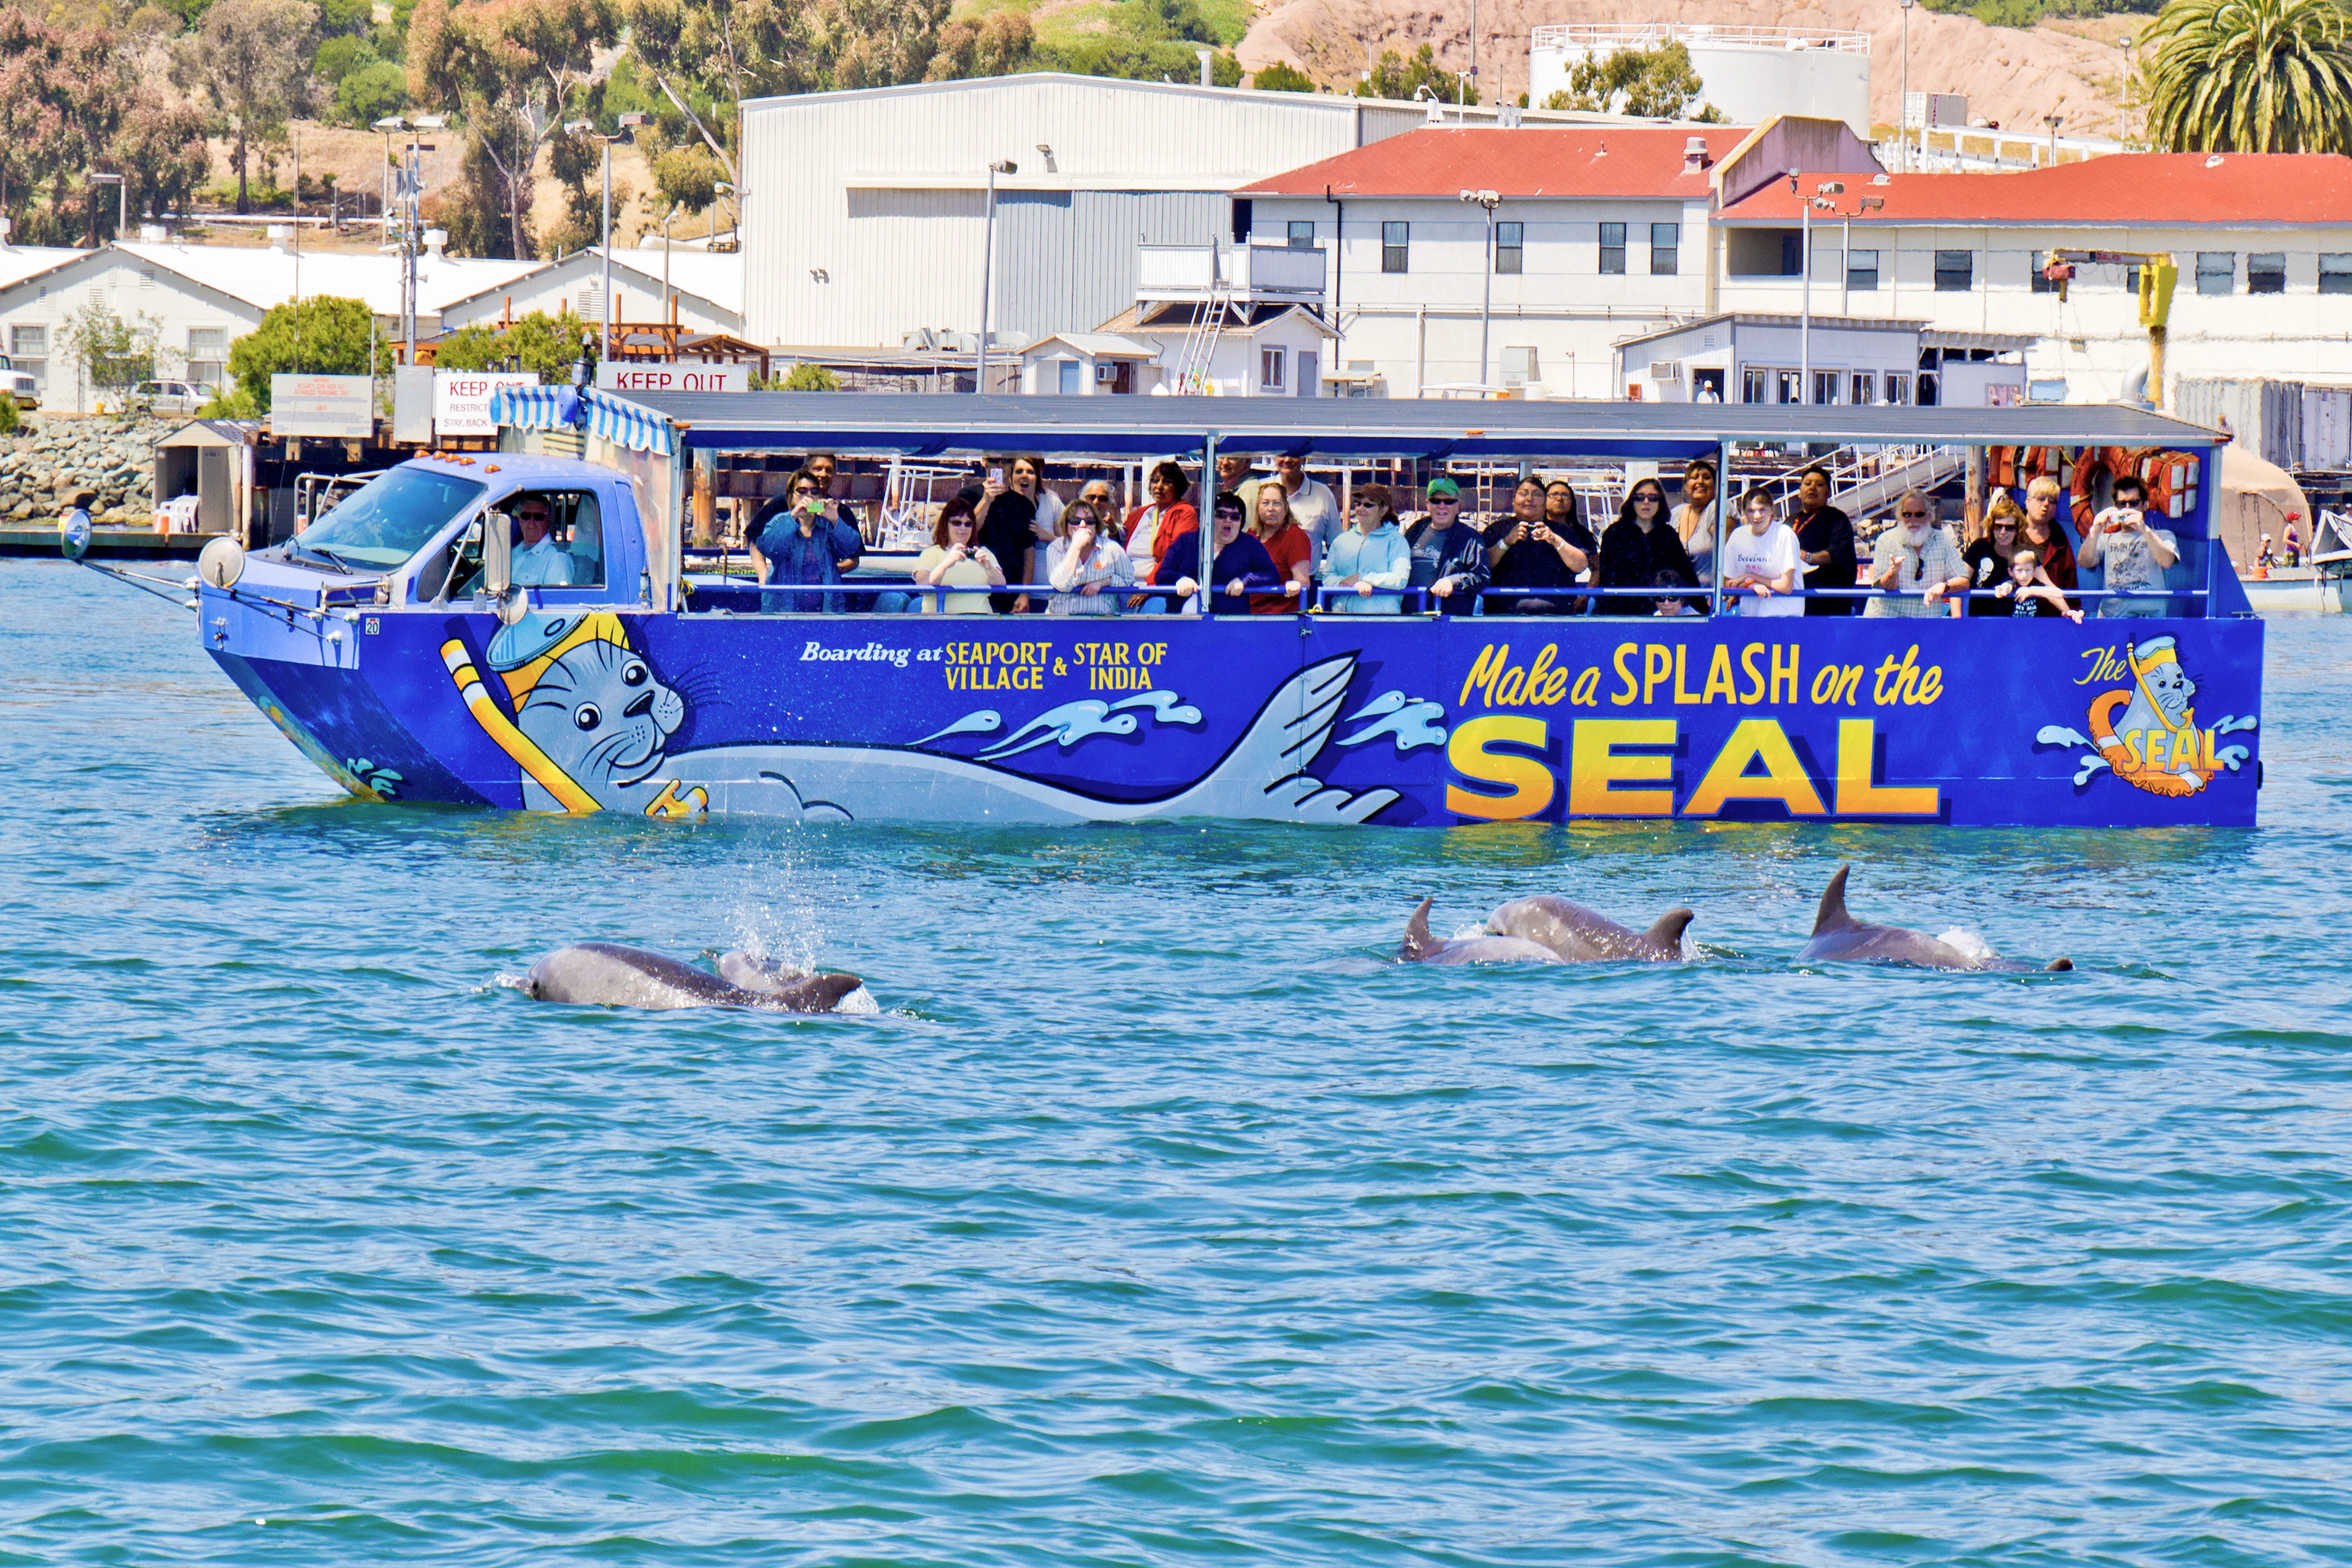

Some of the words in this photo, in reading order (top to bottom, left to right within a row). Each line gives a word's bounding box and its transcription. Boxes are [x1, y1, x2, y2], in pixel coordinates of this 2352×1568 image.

[450, 381, 487, 397] KEEP
[617, 372, 672, 390] KEEP
[683, 373, 727, 391] OUT
[449, 403, 490, 412] RESTRICT
[466, 419, 488, 427] BACK
[367, 622, 378, 634] 20
[800, 642, 911, 668] Boarding
[917, 646, 943, 661] at
[945, 642, 1053, 665] SEAPORT
[1073, 642, 1130, 665] STAR
[1137, 642, 1168, 664] OF
[2073, 645, 2127, 685] The
[945, 666, 1044, 690] VILLAGE
[1053, 657, 1068, 676] &
[1090, 666, 1152, 690] INDIA
[1459, 643, 1569, 707] Make
[1571, 666, 1601, 707] a
[1611, 642, 1800, 706] SPLASH
[1811, 664, 1865, 706] on
[1873, 644, 1944, 706] the
[2122, 728, 2224, 772] SEAL
[1444, 714, 1940, 821] SEAL
